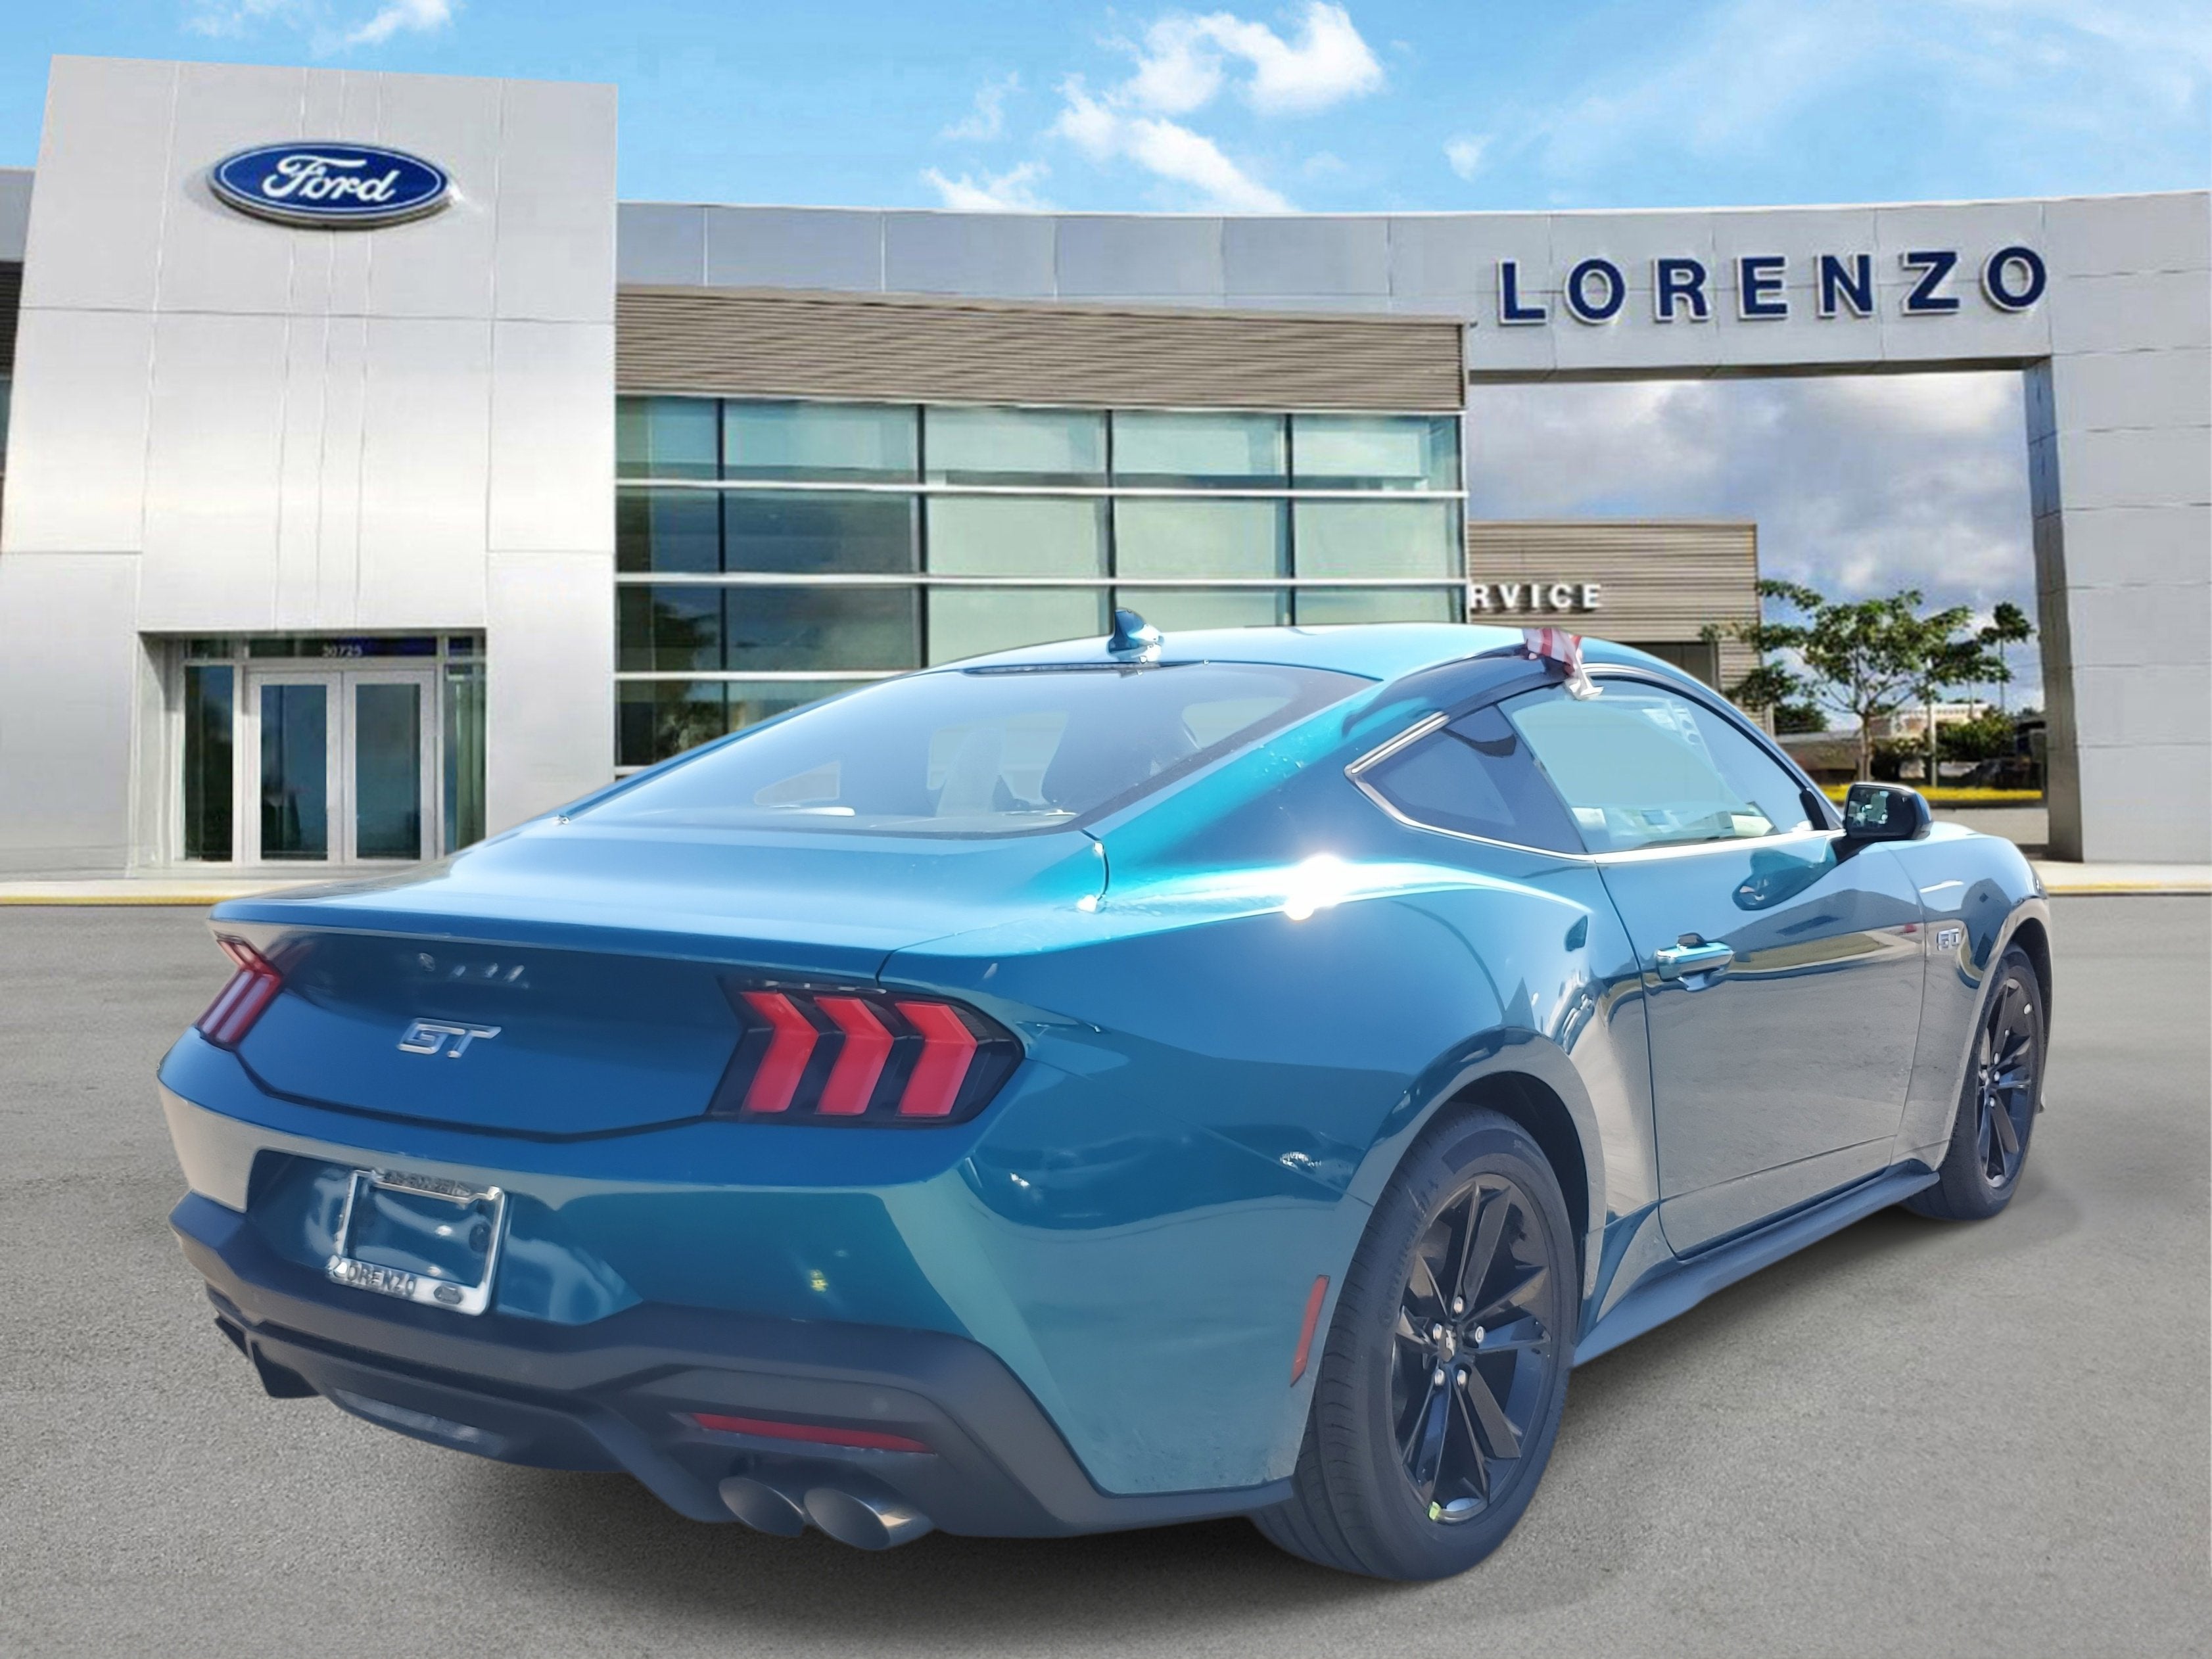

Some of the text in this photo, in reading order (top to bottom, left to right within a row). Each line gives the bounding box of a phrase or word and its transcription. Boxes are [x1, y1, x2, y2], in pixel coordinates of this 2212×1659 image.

[263, 154, 401, 202] Ford
[1499, 246, 2047, 323] LORENZO
[396, 1017, 502, 1058] GT
